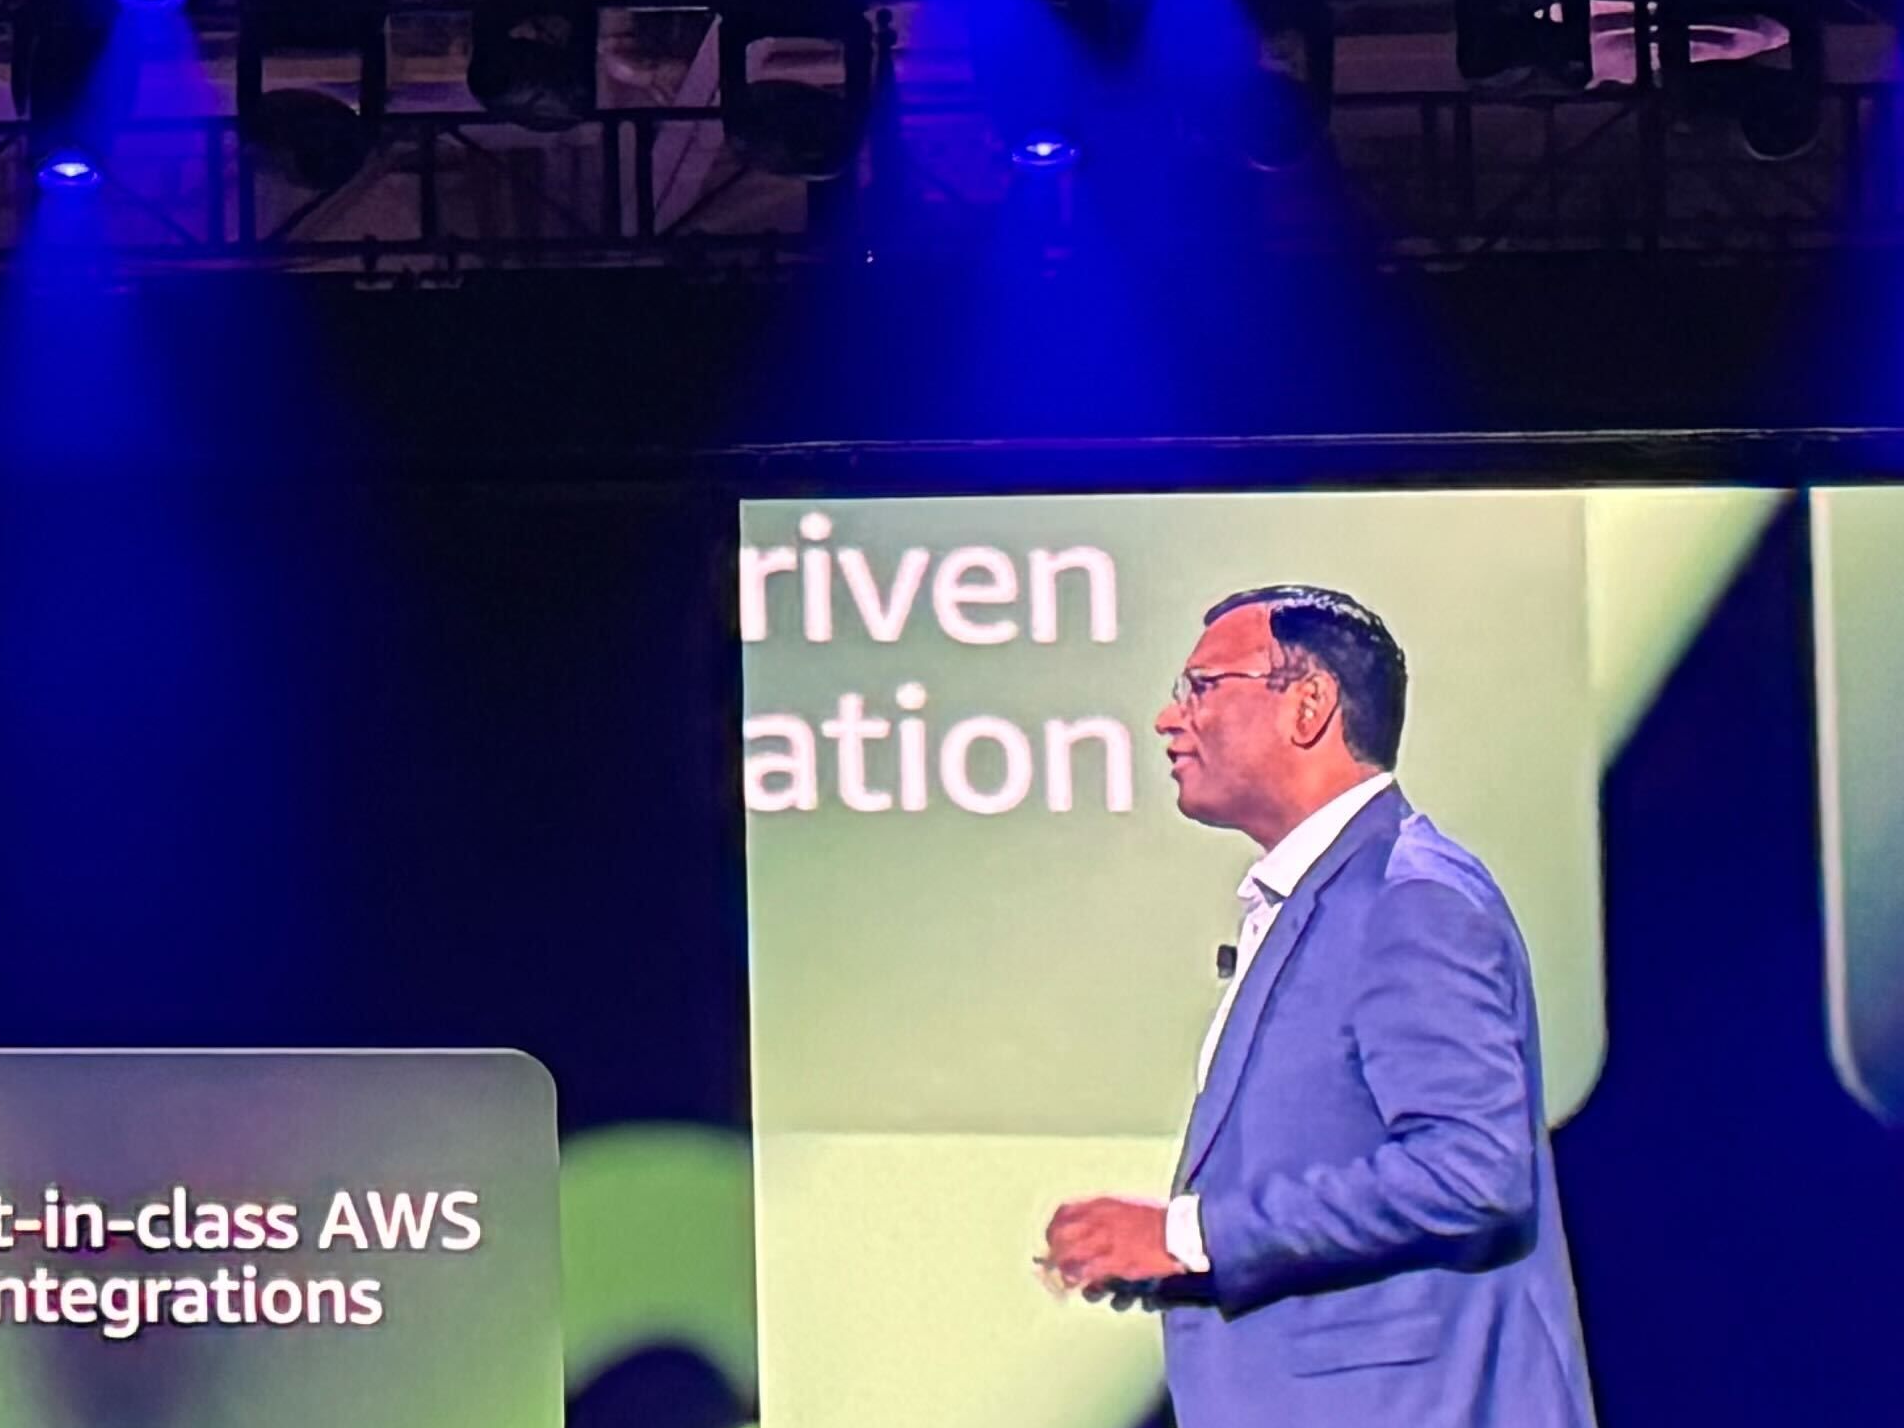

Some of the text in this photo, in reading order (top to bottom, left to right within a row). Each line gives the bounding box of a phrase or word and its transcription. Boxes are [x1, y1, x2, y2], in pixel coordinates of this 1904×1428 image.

[740, 512, 1118, 644] riven
[743, 682, 1133, 814] ation
[318, 1189, 481, 1251] AWS
